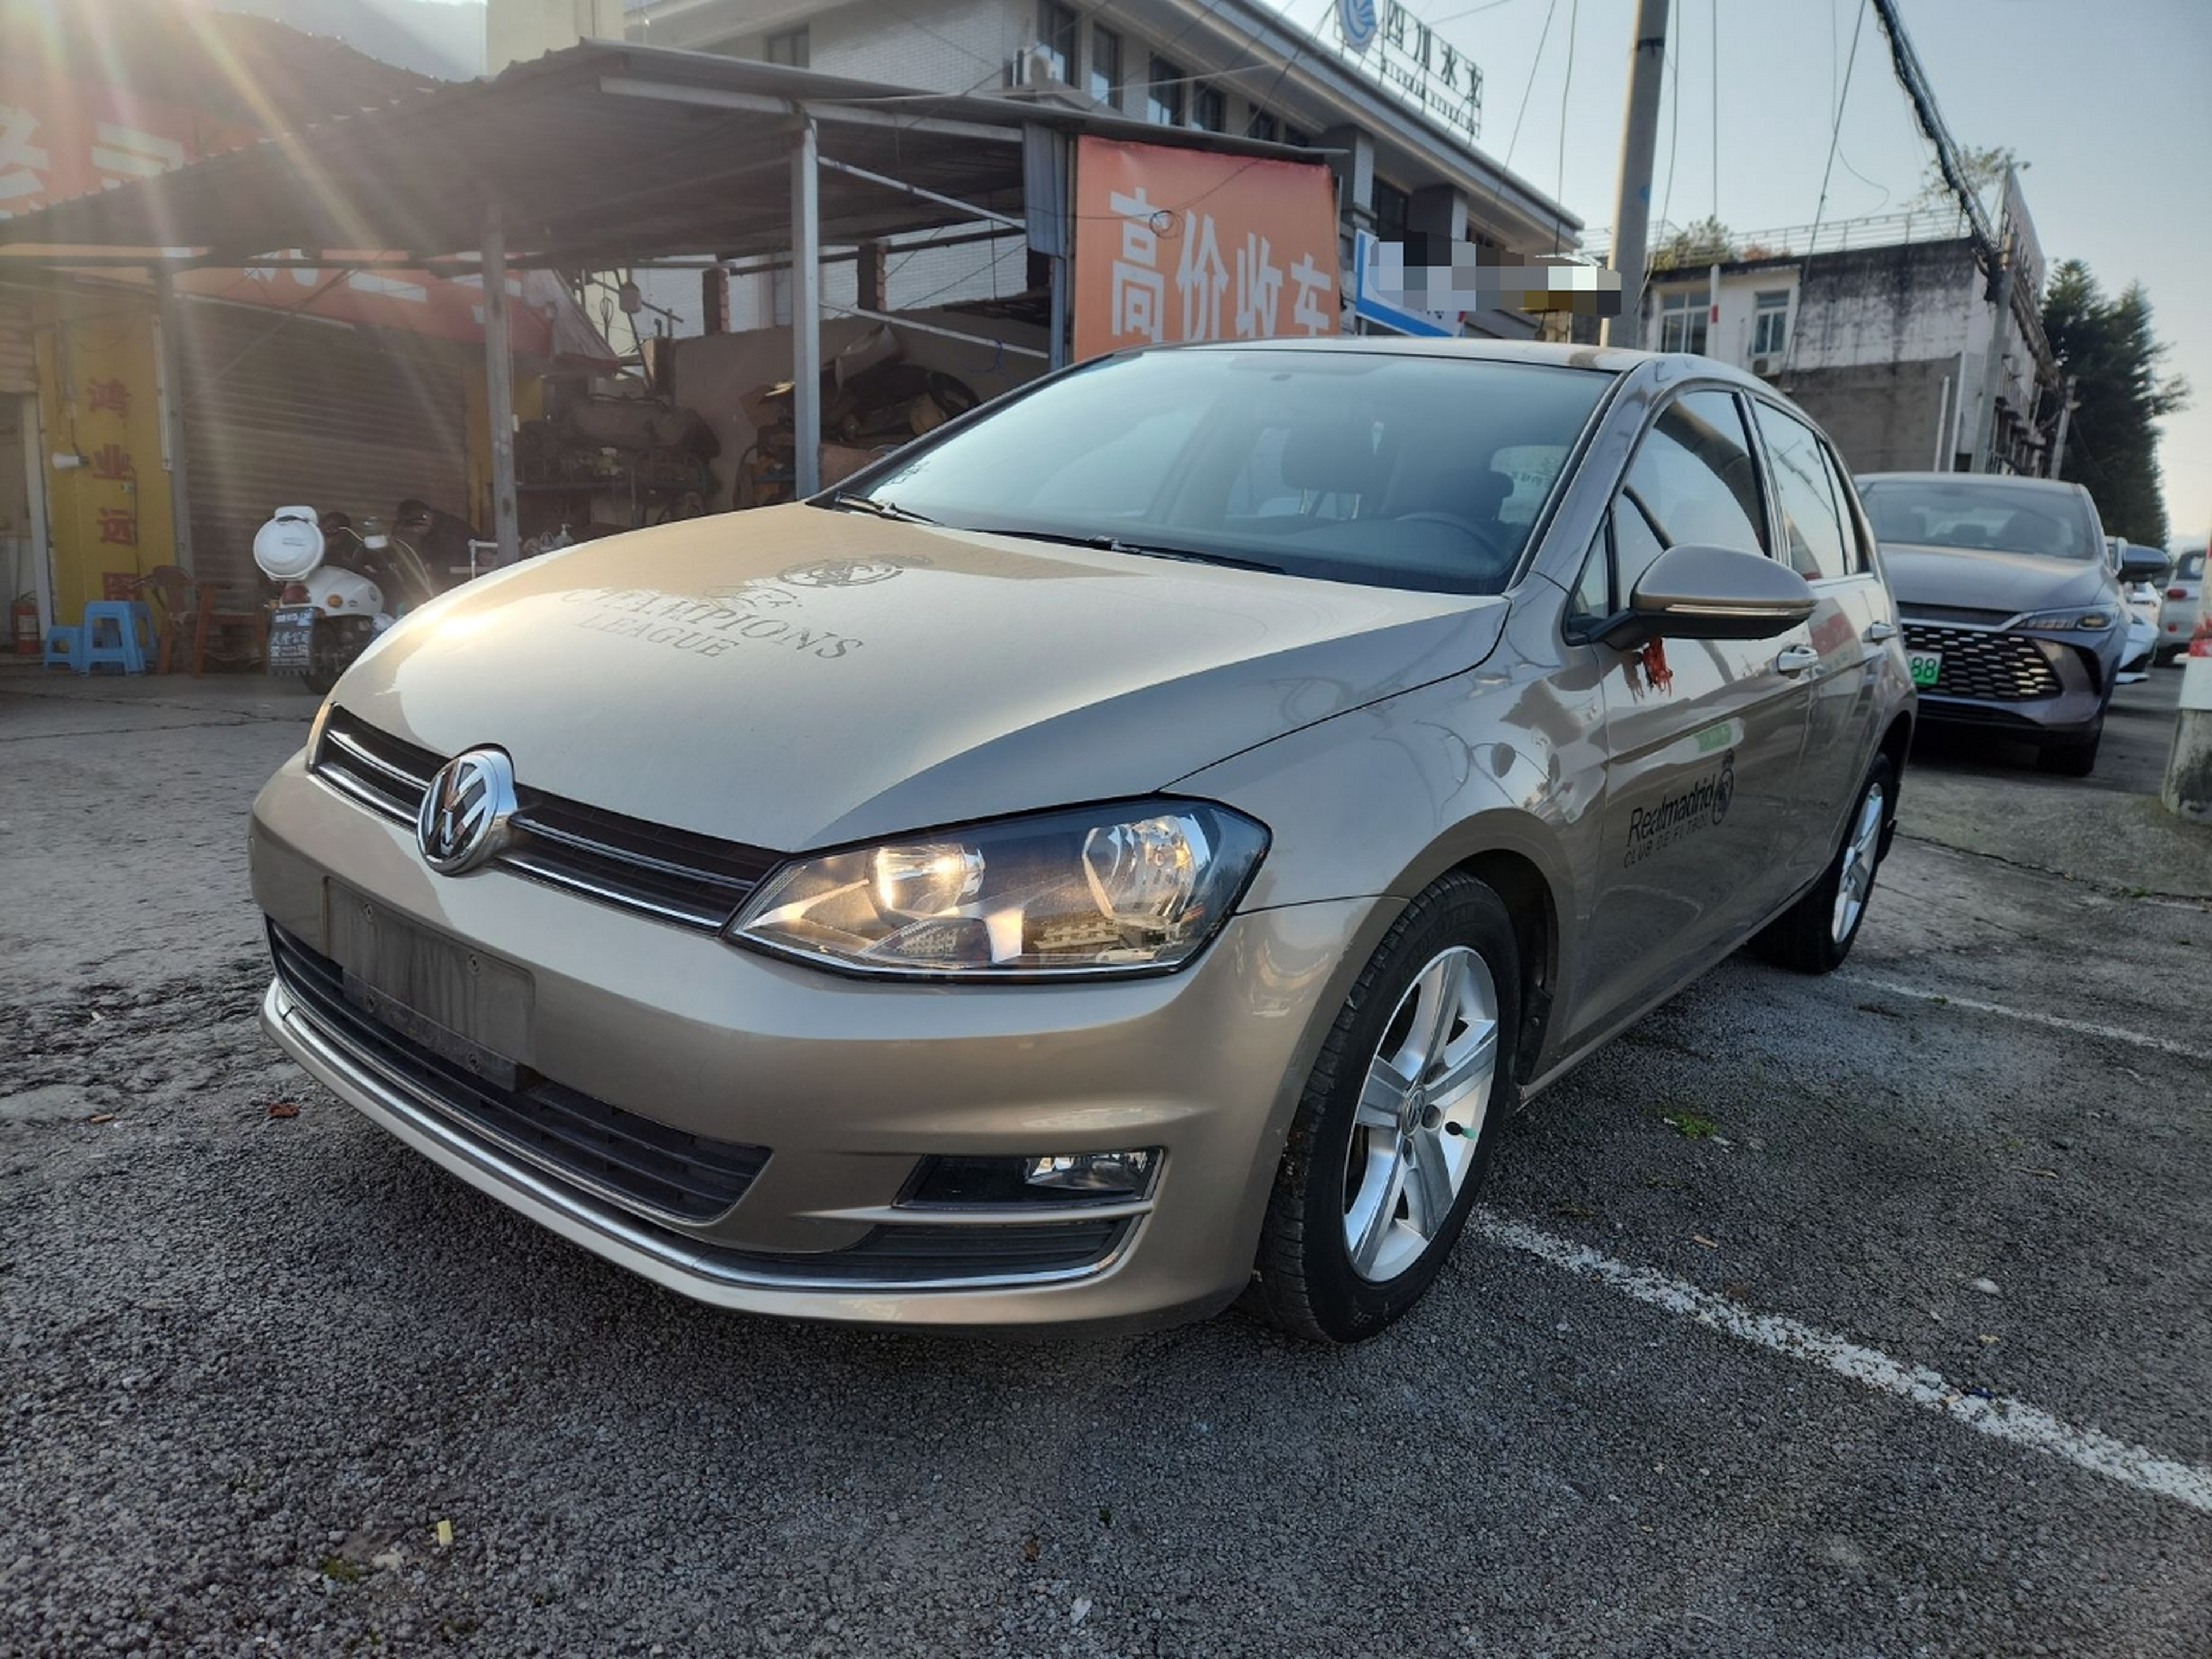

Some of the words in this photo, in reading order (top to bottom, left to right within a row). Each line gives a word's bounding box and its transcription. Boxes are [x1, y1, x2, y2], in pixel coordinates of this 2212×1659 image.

[1110, 186, 1331, 344] 高价收车
[576, 613, 740, 657] LEAGUE
[1912, 657, 1937, 679] 88
